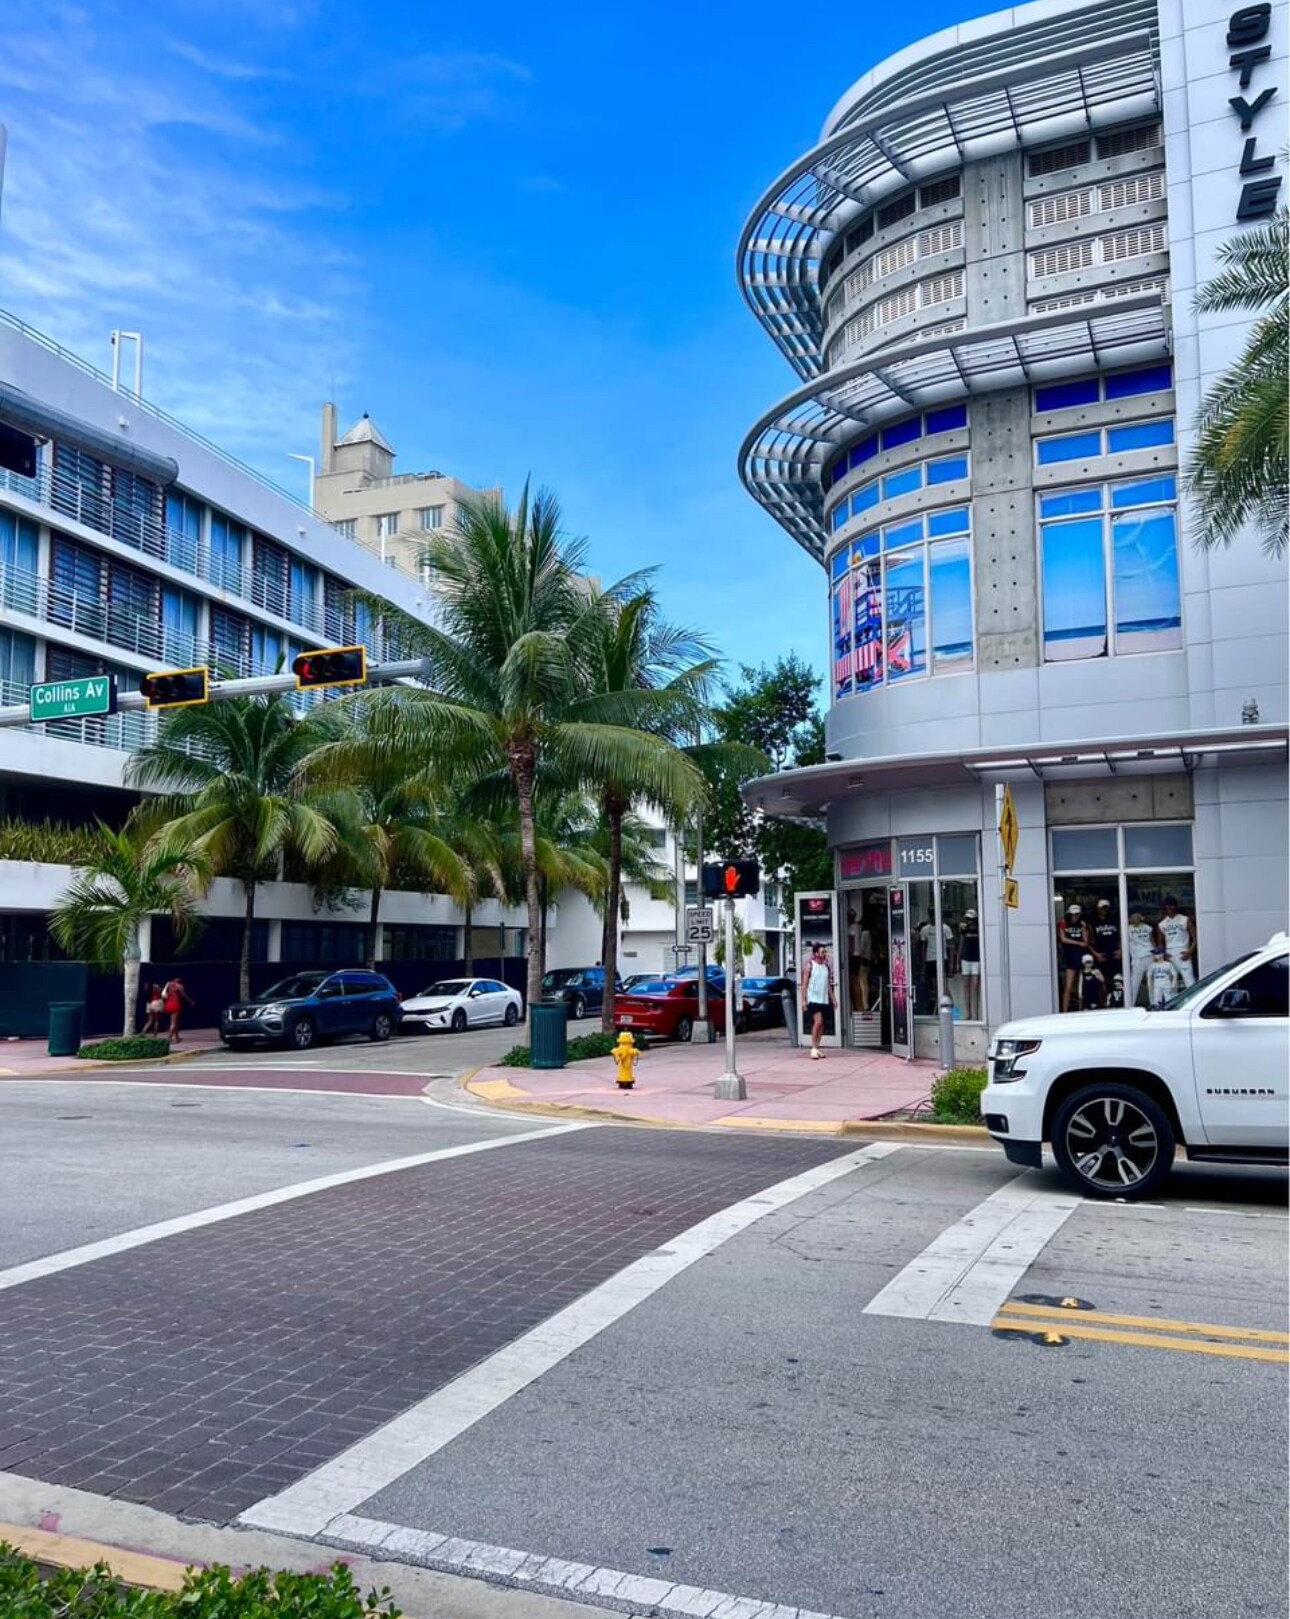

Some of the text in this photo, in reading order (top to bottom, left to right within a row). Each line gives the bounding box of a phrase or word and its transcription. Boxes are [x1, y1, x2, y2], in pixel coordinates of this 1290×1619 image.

[1226, 2, 1282, 220] STYLE
[36, 681, 104, 704] Collins Av
[900, 848, 934, 863] 1155
[690, 926, 711, 939] 25
